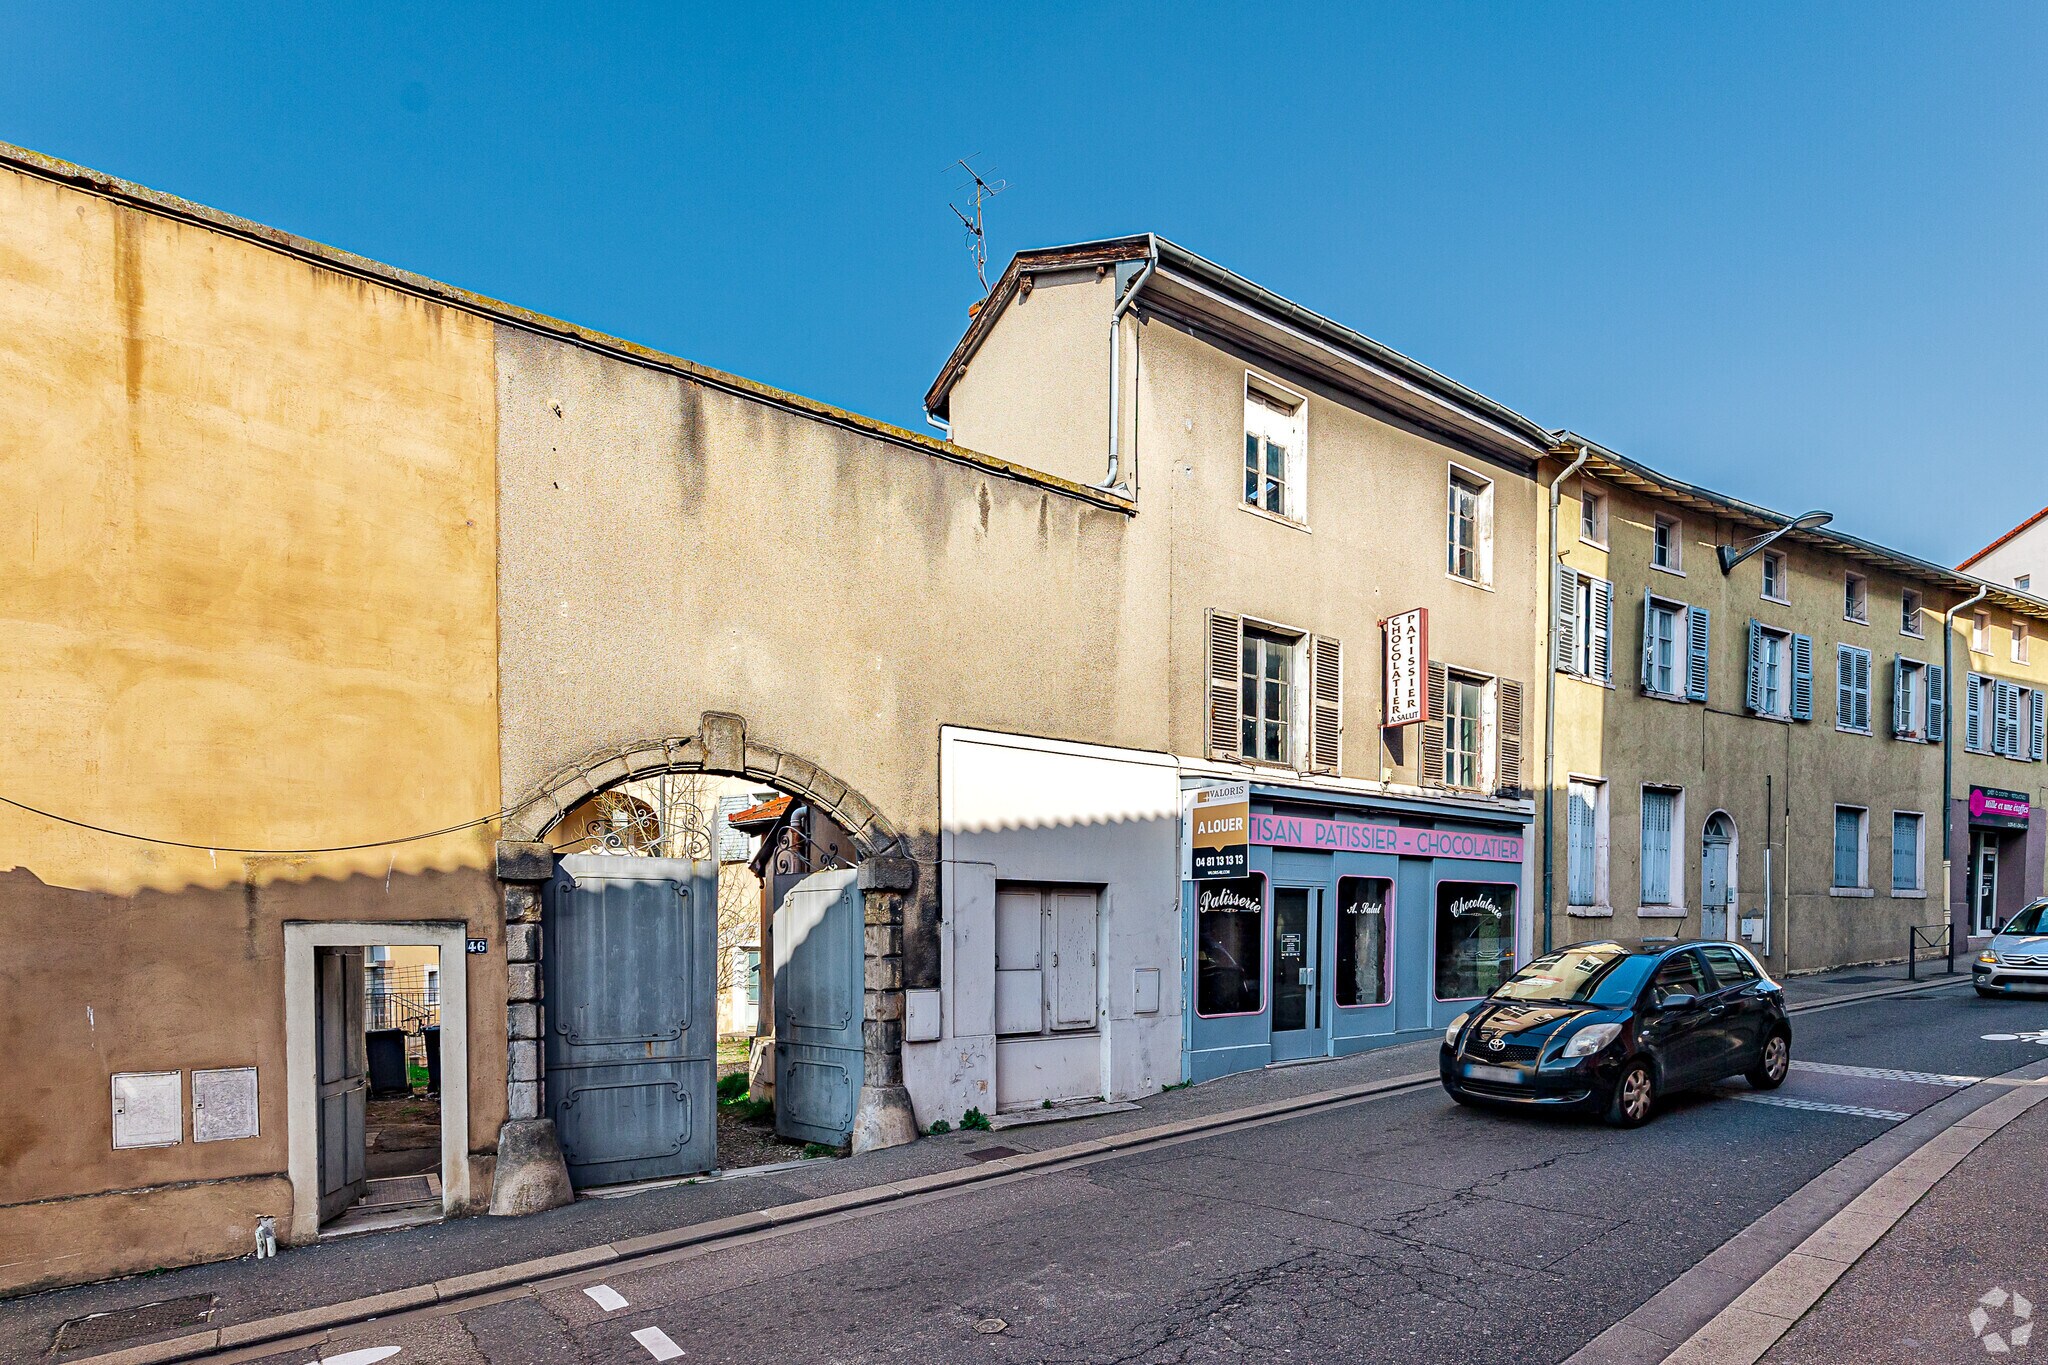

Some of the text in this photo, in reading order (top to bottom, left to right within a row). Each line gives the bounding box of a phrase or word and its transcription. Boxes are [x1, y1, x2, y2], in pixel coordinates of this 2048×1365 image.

[1391, 617, 1401, 714] CHOCOLATIER
[1406, 614, 1416, 708] PATISSIER
[1210, 786, 1244, 798] VALORIS
[1197, 817, 1243, 835] A LOUER
[1249, 816, 1302, 843] TISAN
[1315, 822, 1397, 850] PATISSIER
[1417, 832, 1519, 859] CHOCOLATIER
[1195, 854, 1244, 867] 04 81 13 13 13
[1200, 888, 1261, 914] Patisserie
[1450, 893, 1503, 919] Chocolaterie
[468, 941, 486, 952] 46
